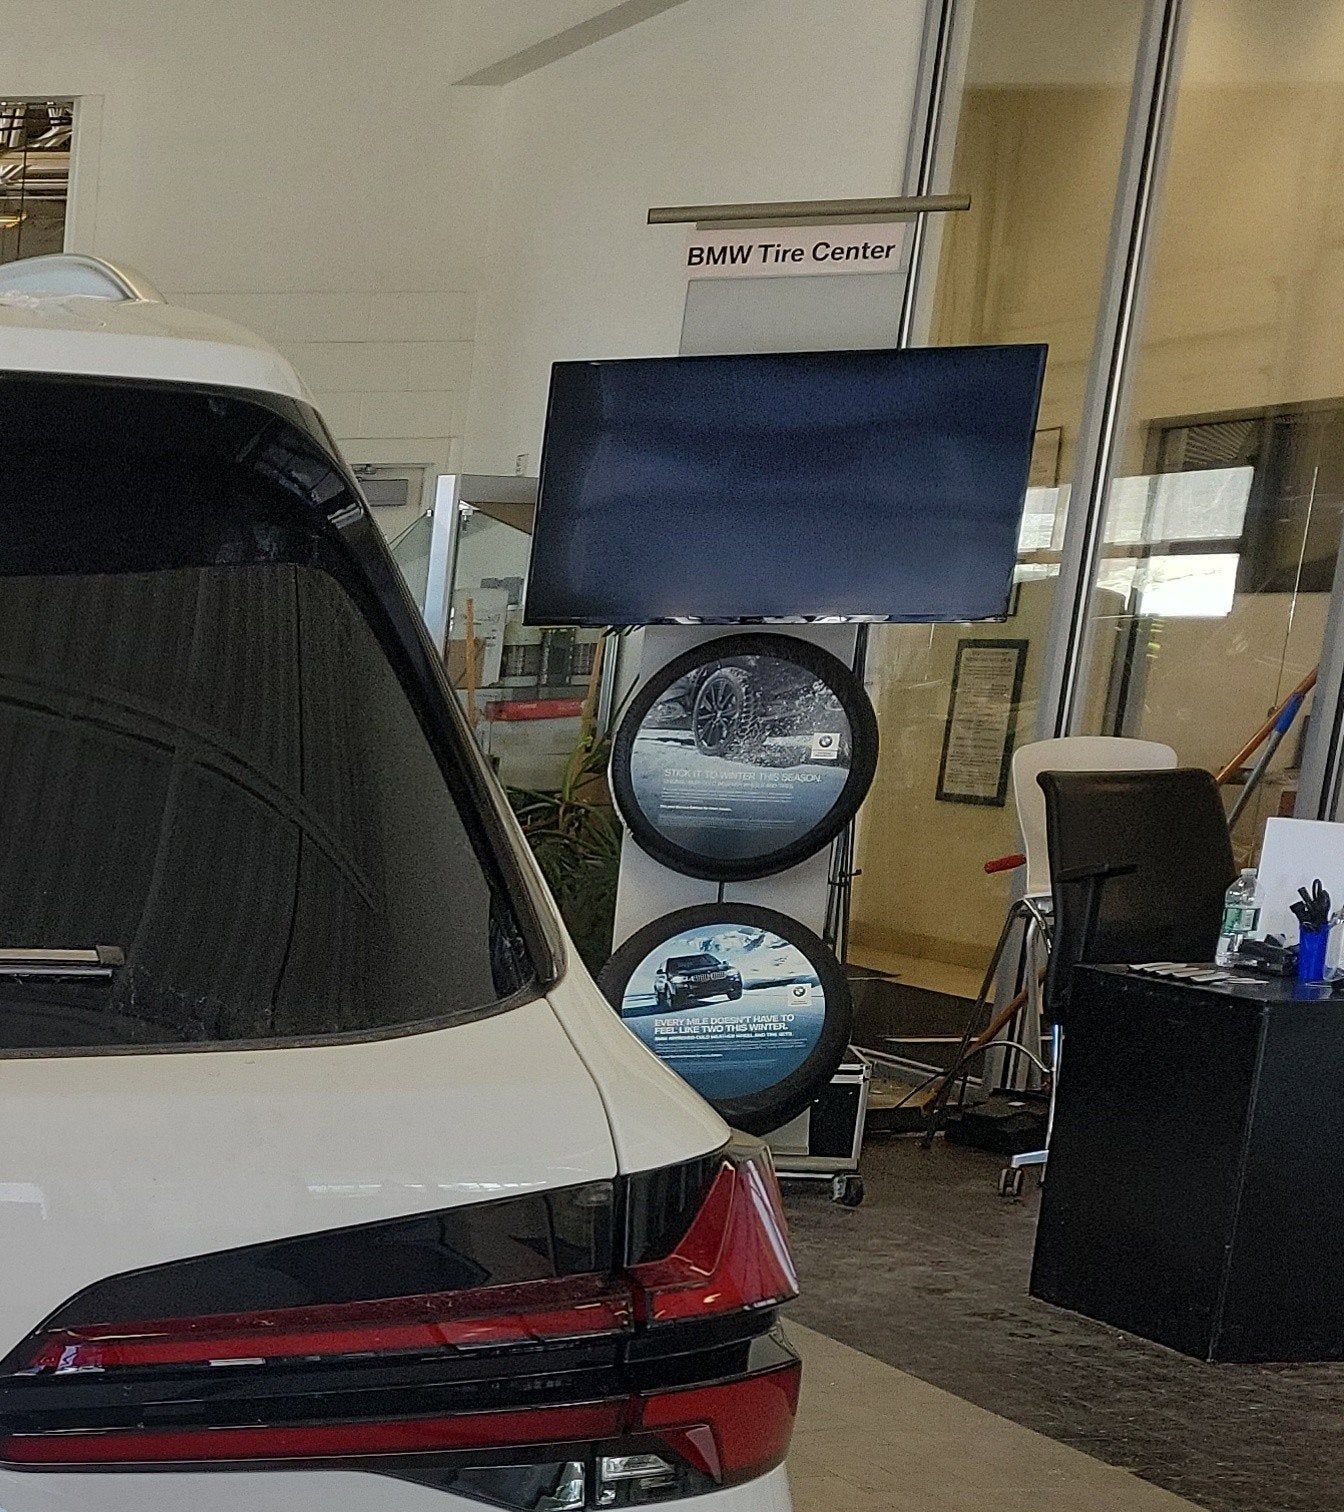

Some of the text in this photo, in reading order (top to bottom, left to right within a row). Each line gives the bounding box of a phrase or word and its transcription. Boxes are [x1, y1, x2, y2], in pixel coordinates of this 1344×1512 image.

[687, 241, 897, 267] BMW Tire Center
[664, 769, 691, 778] STICK
[693, 770, 703, 778] IT
[705, 771, 718, 779] TO
[720, 771, 756, 780] WINTER
[760, 772, 780, 782] THIS
[654, 1013, 795, 1027] EVERY MILE DOESN'T HAVE TO
[654, 1022, 789, 1035] FEEL LIKE TWO THIS WINTER.
